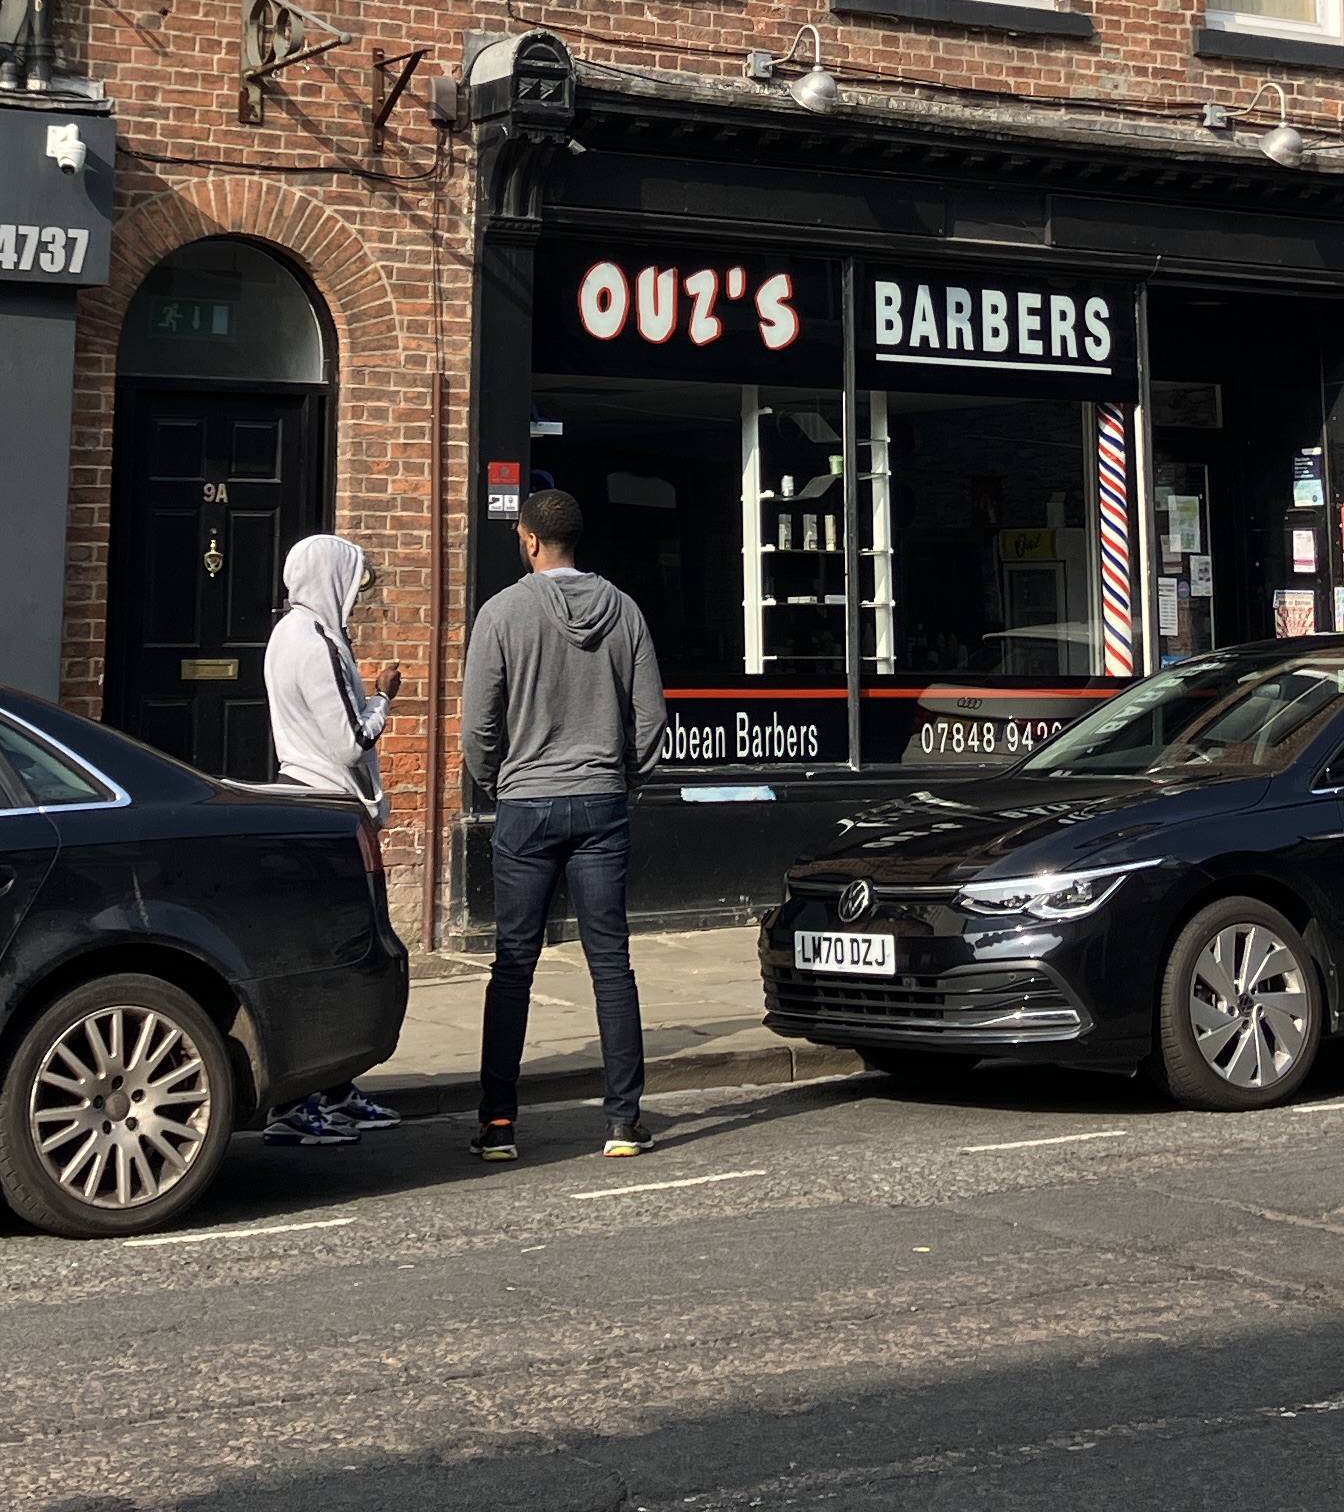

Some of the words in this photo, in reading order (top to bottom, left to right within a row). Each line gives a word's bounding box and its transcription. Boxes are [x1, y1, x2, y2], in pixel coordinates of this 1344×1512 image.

[577, 260, 799, 351] OUZ'S
[874, 279, 1113, 363] BARBERS
[203, 483, 228, 503] 9A
[736, 711, 818, 758] Barbers
[921, 722, 995, 754] 07848
[801, 935, 844, 966] LM70
[849, 937, 886, 967] DZJ
